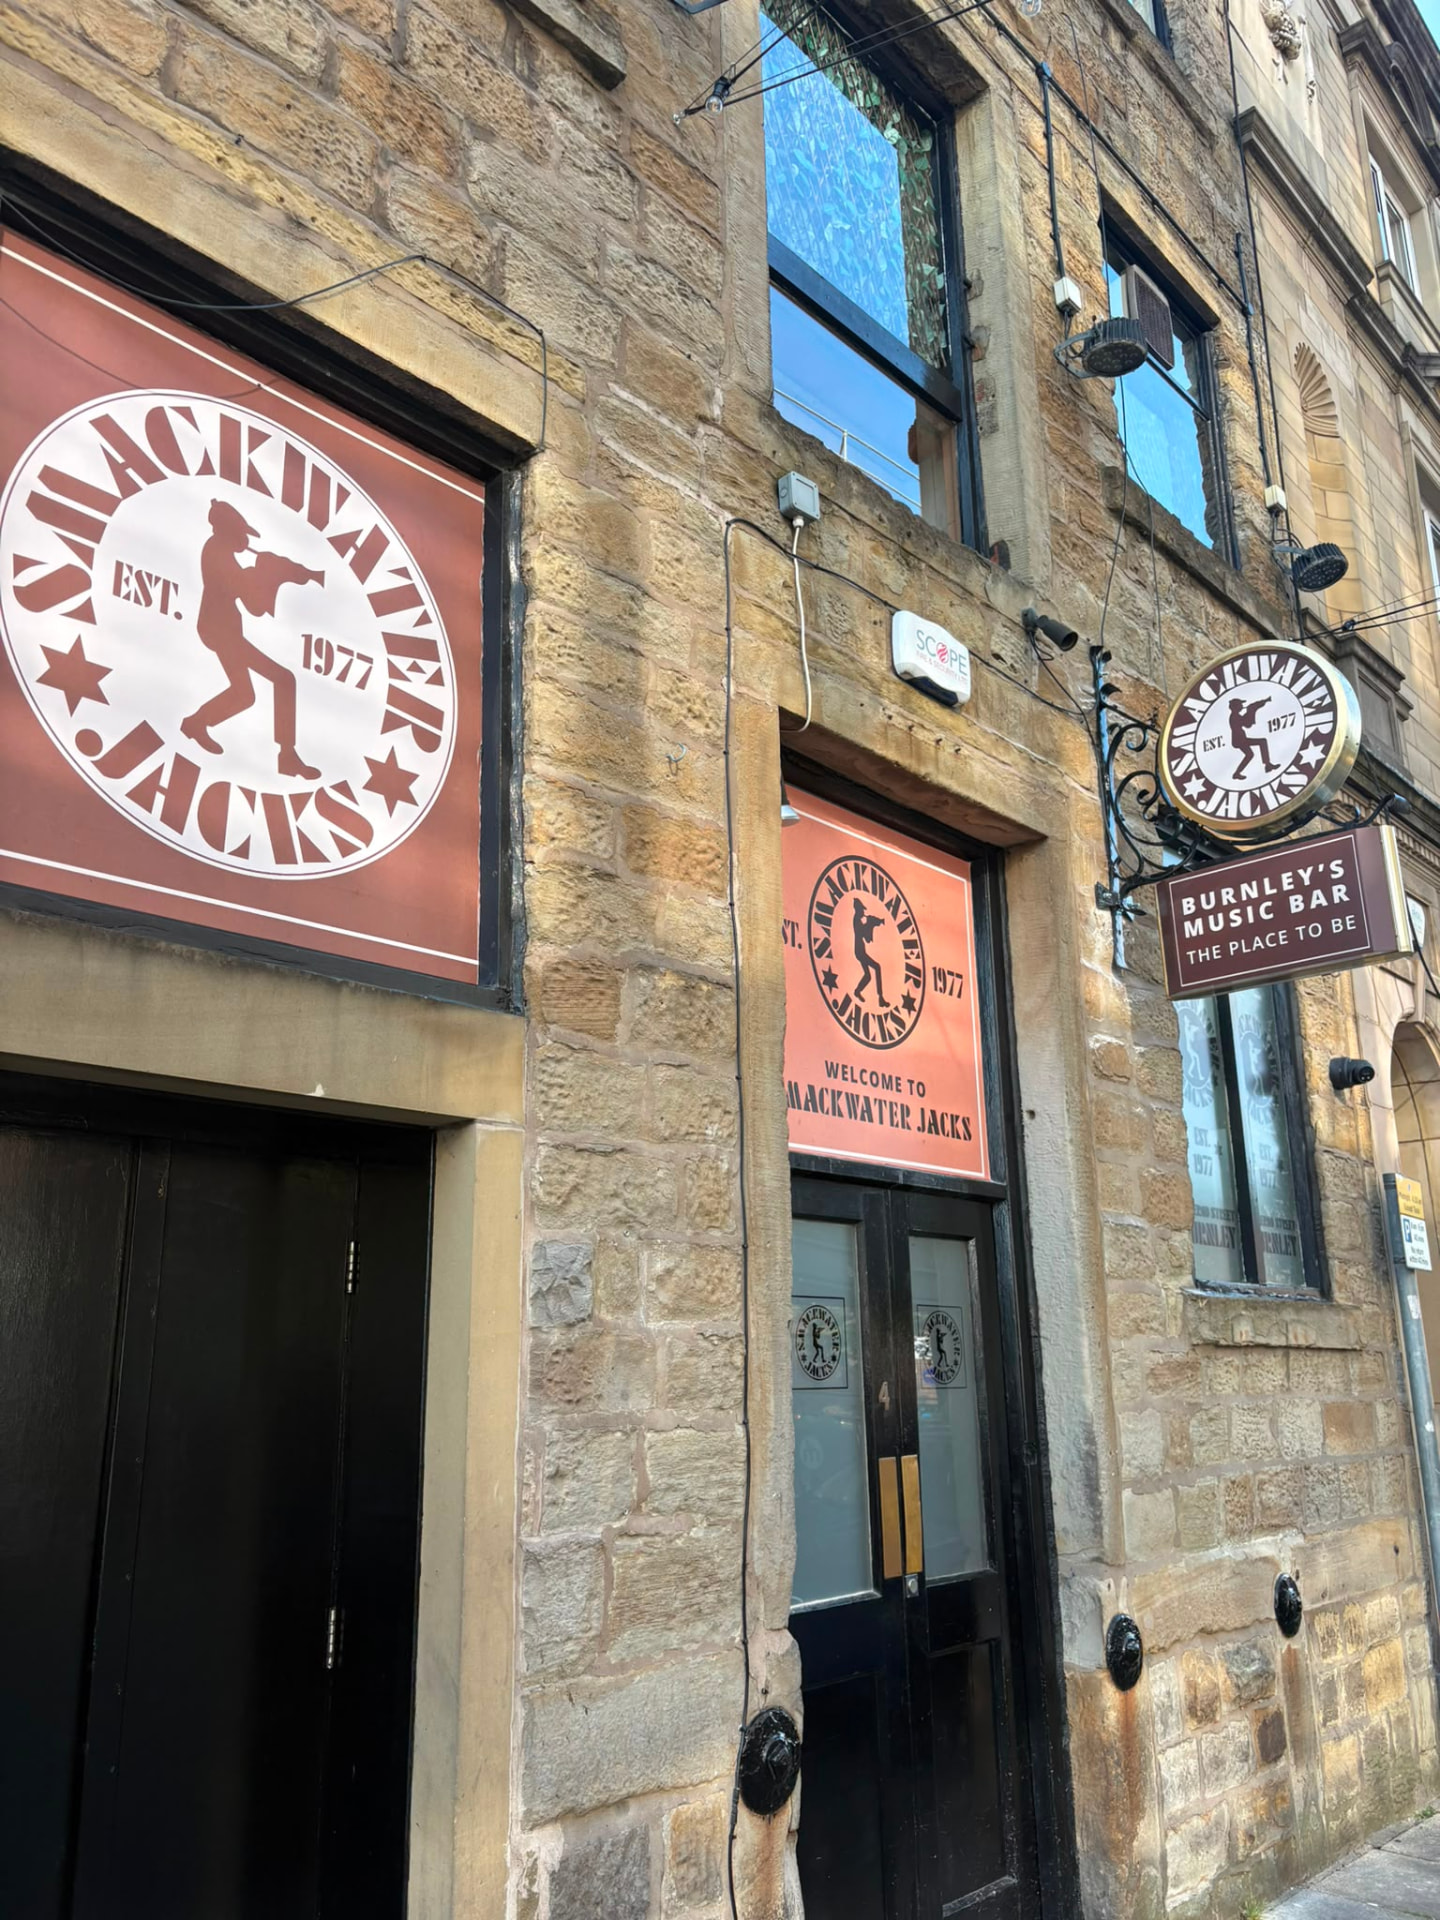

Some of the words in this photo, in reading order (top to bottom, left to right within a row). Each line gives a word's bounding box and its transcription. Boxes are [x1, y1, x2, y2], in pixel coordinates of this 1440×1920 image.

[13, 406, 445, 753] SMACKWATER
[113, 559, 183, 620] EST.
[301, 633, 374, 690] 1977
[916, 629, 968, 676] SCOPE
[1171, 654, 1334, 777] SMACKWATER
[1267, 713, 1297, 733] 1977
[1202, 735, 1226, 752] EST.
[74, 719, 375, 866] JACKS
[1198, 766, 1308, 818] JACKS
[1181, 859, 1345, 916] BURNLEY'S
[1183, 901, 1275, 938] MUSIC
[1290, 884, 1350, 914] BAR
[781, 918, 802, 949] ST.
[813, 862, 922, 989] SMACKWATER
[1186, 946, 1222, 965] THE
[1229, 930, 1289, 957] PLACE
[1295, 922, 1323, 941] TO
[1331, 915, 1356, 934] BE
[932, 966, 963, 999] 1977
[832, 993, 906, 1043] JACKS
[825, 1060, 902, 1093] WELCOME
[907, 1079, 926, 1098] TO
[787, 1080, 912, 1130] MACKWATER
[917, 1107, 972, 1141] JACKS
[879, 1381, 891, 1412] 4
